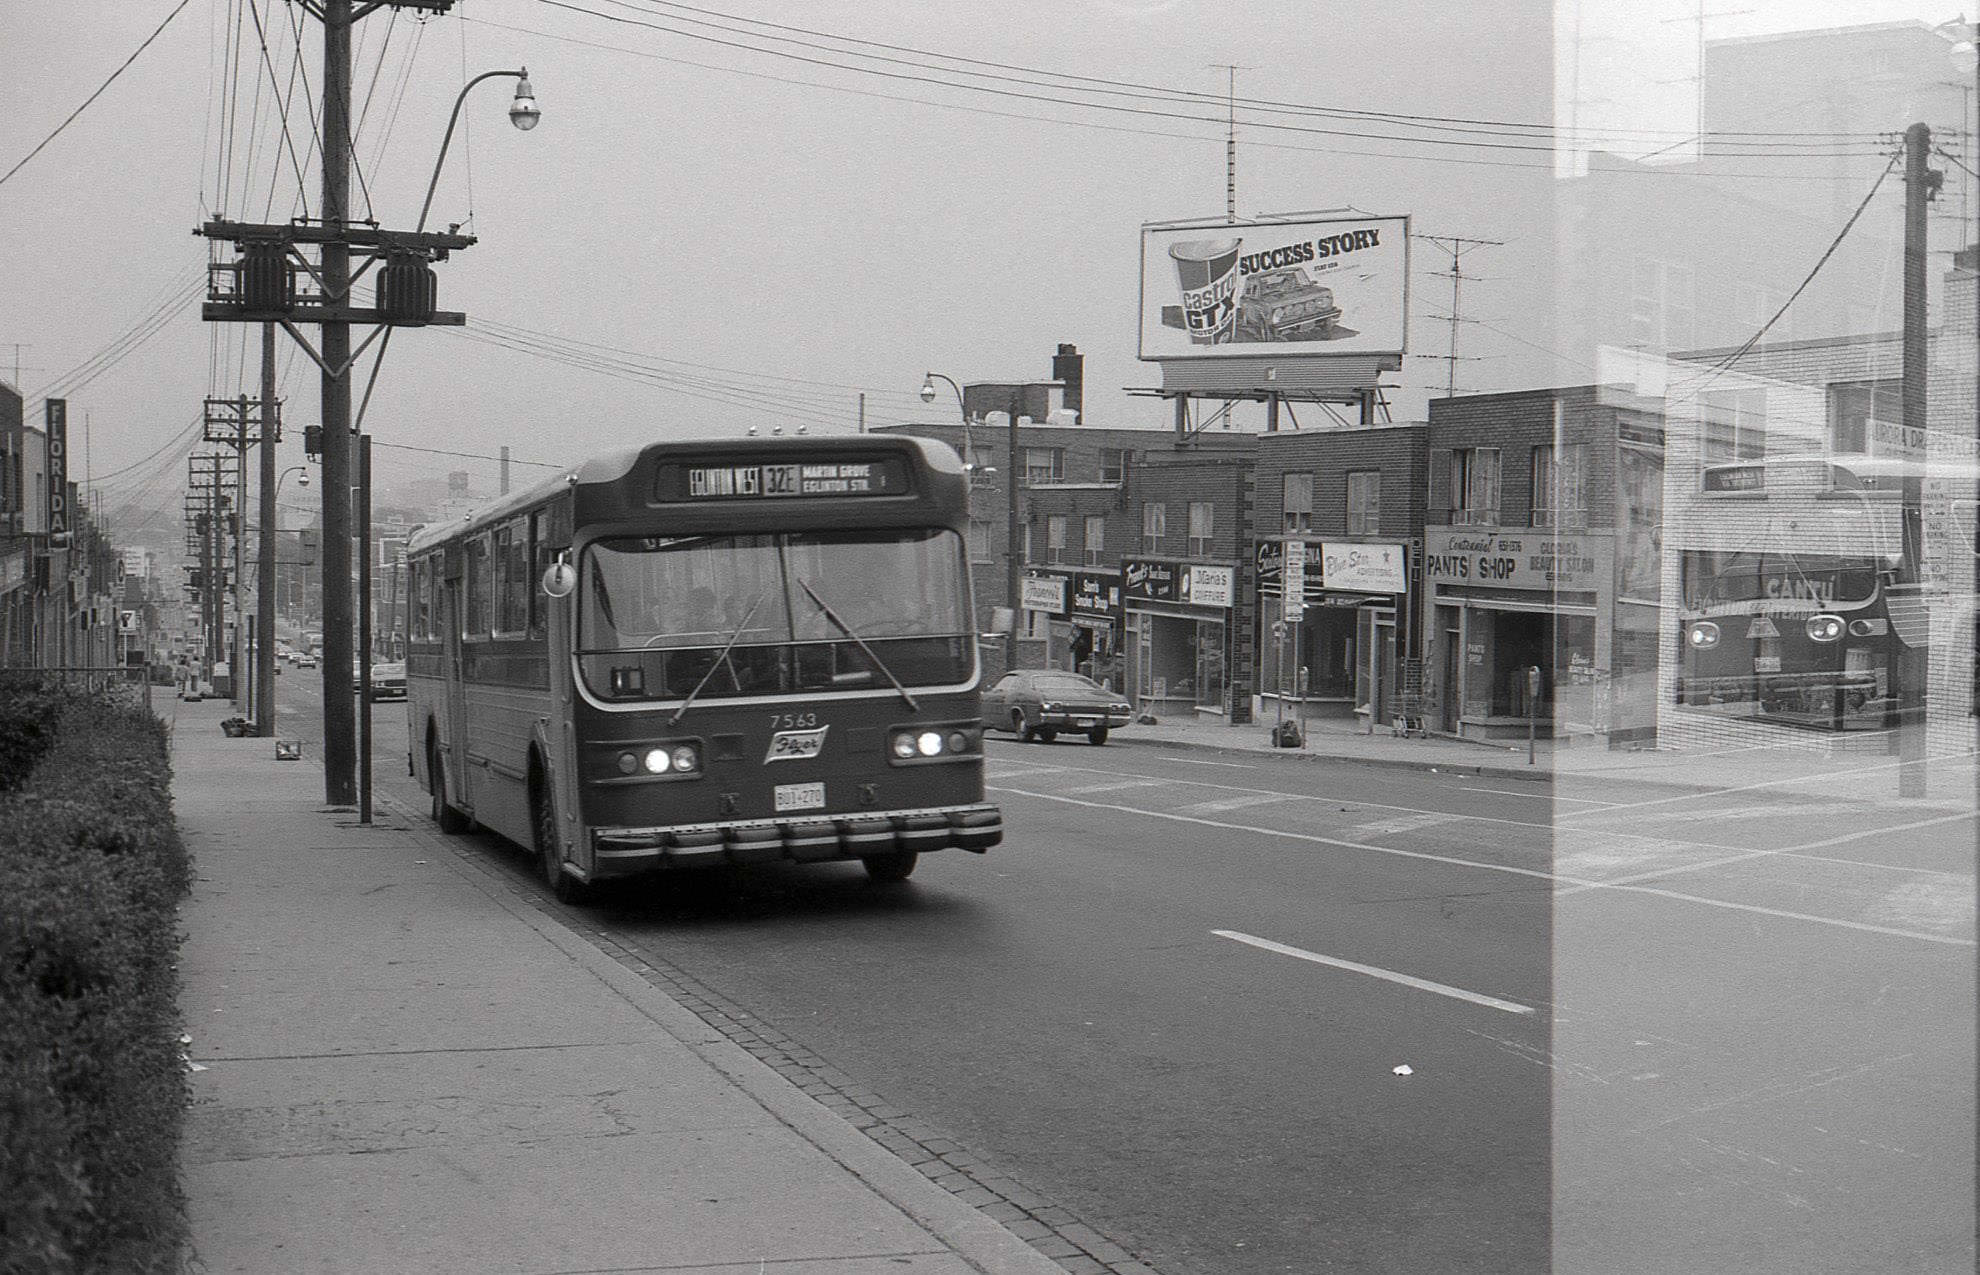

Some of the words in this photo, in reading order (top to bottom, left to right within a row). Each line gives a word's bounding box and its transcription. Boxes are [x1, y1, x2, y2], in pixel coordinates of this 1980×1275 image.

[1239, 241, 1314, 276] SUCCESS
[1317, 228, 1381, 259] STORY
[1186, 287, 1235, 330] GTX
[50, 404, 65, 531] FLORIDA
[766, 466, 795, 494] 32E
[1427, 555, 1468, 578] PANTS
[1478, 557, 1516, 580] SHOP
[769, 712, 817, 729] 7563
